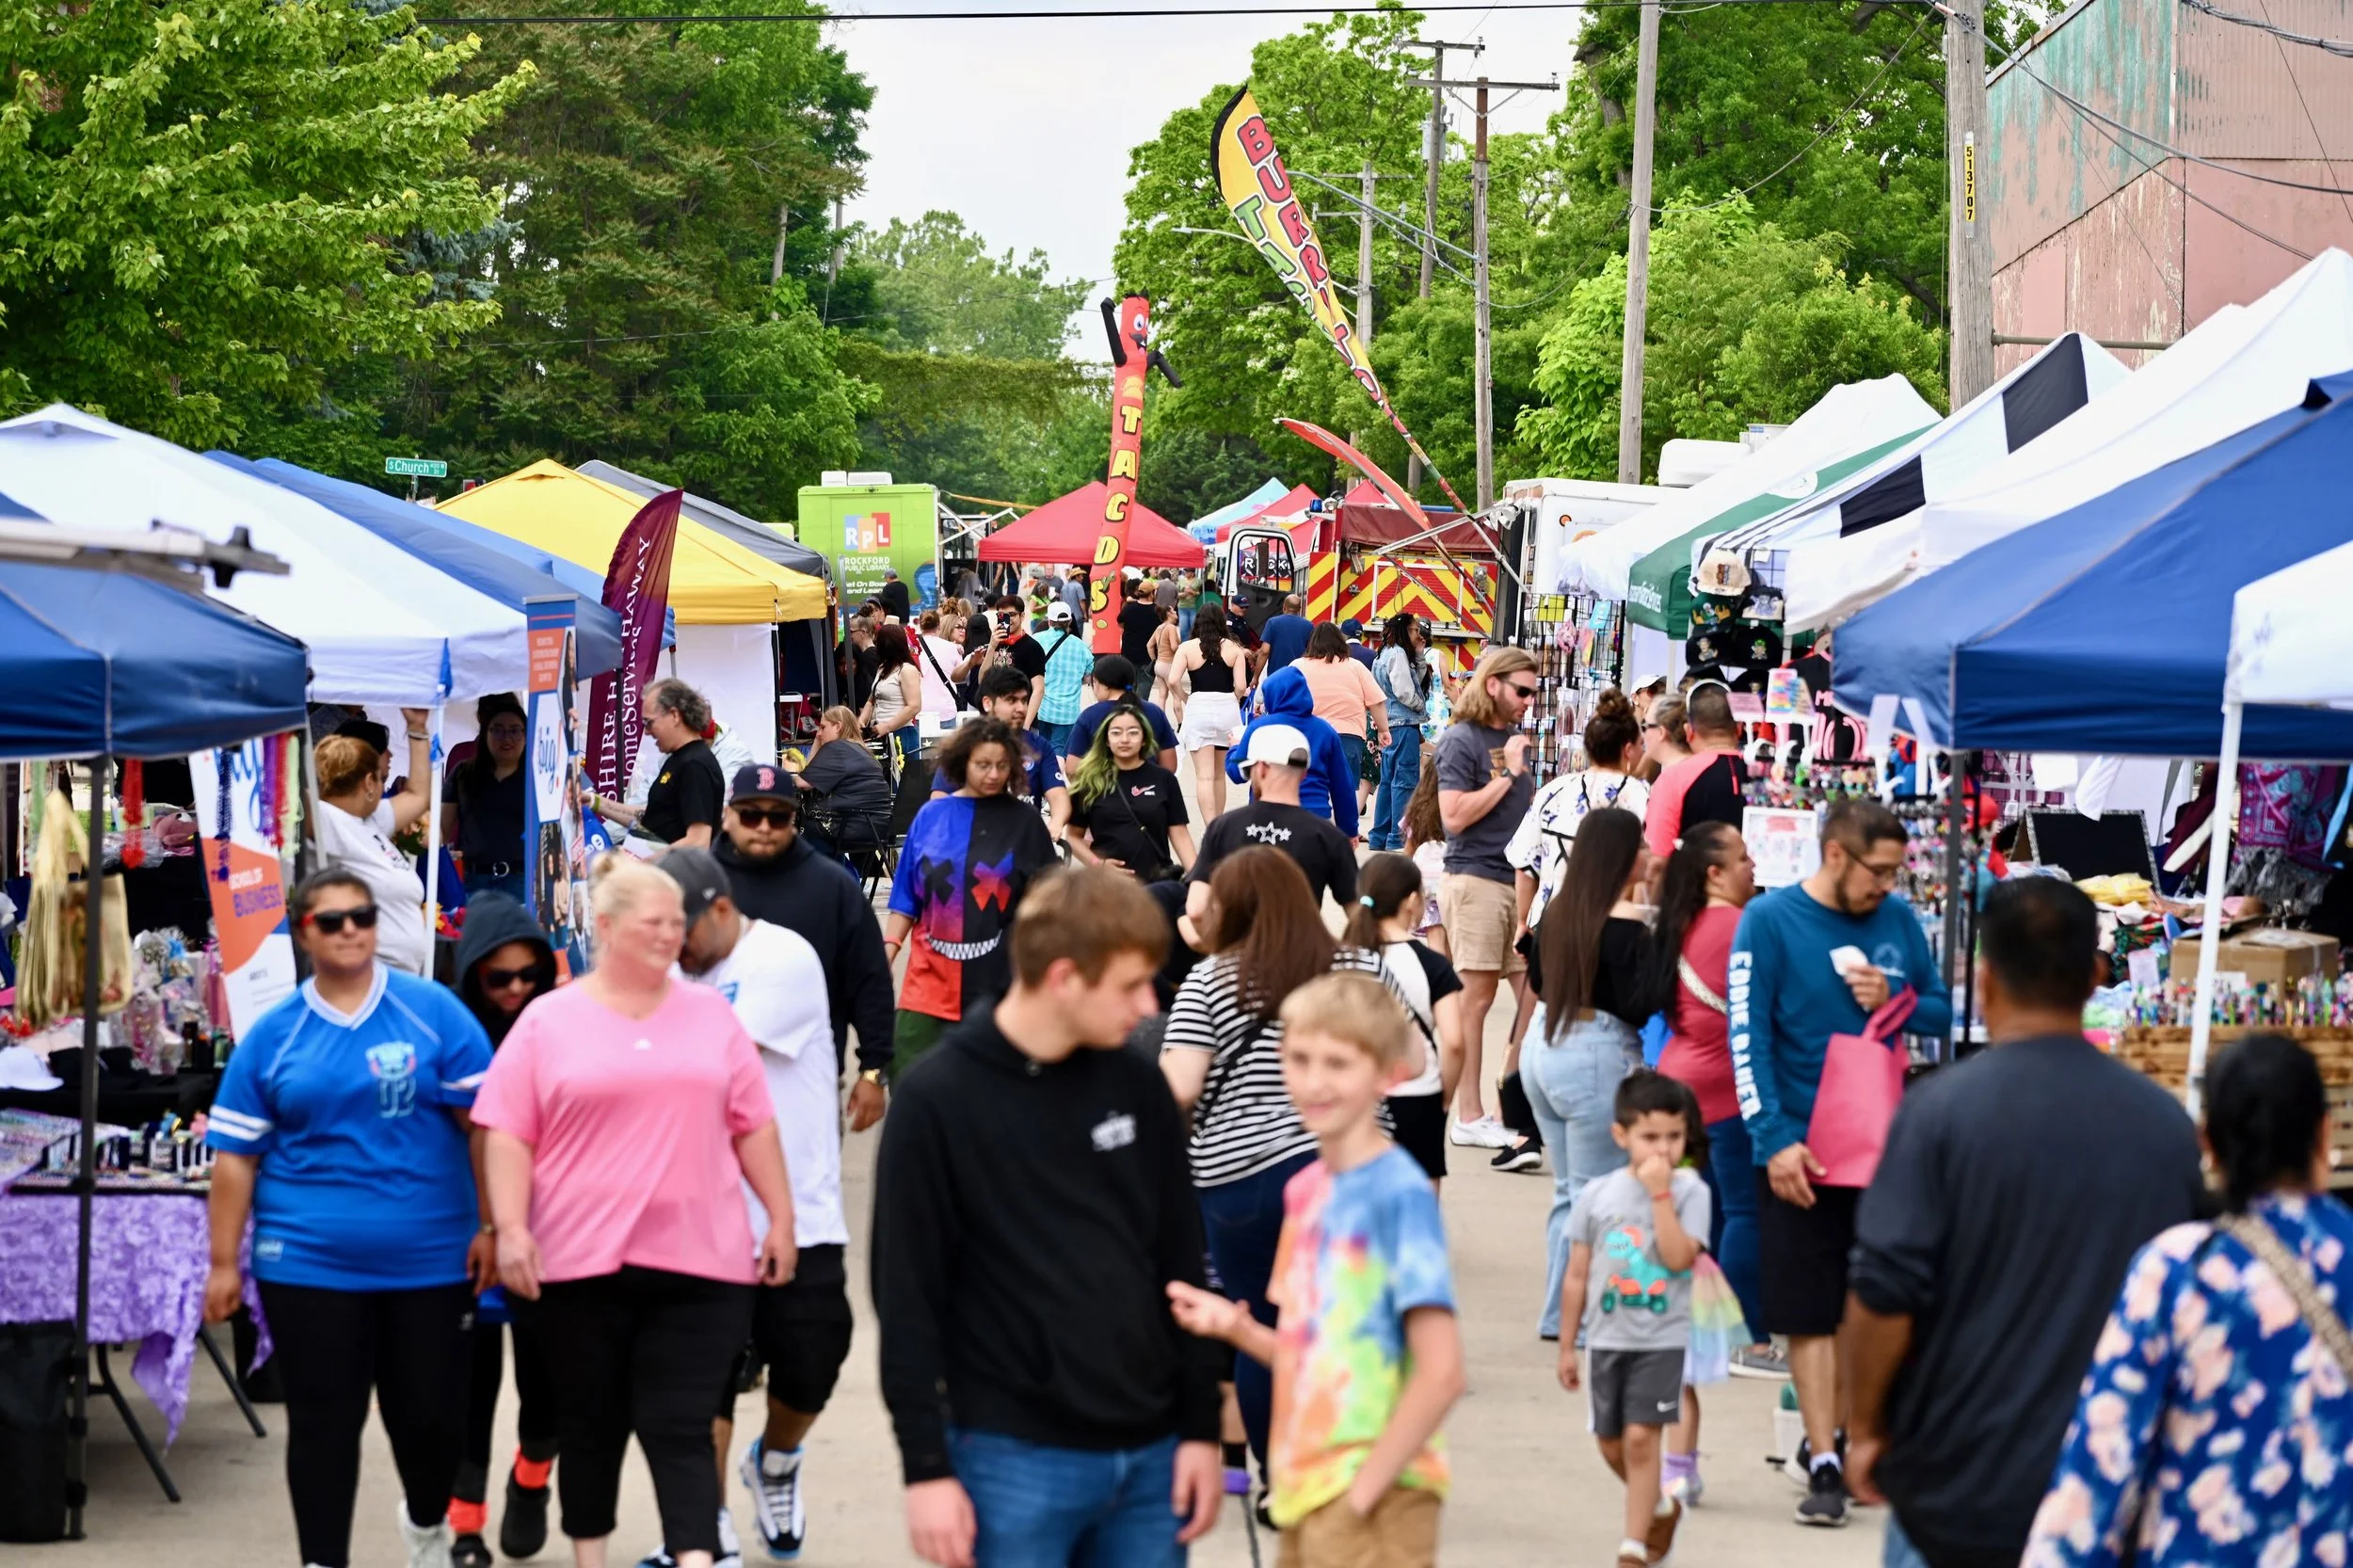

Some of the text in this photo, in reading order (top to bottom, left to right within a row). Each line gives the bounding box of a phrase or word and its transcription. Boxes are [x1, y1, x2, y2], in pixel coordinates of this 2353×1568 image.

[389, 461, 393, 470] S
[395, 459, 429, 473] Church
[845, 524, 889, 550] RPL
[844, 556, 890, 565] ROCKFORD
[1244, 558, 1290, 570] RCK
[757, 767, 776, 791] B
[1728, 951, 1762, 1121] EDDIE BAUER
